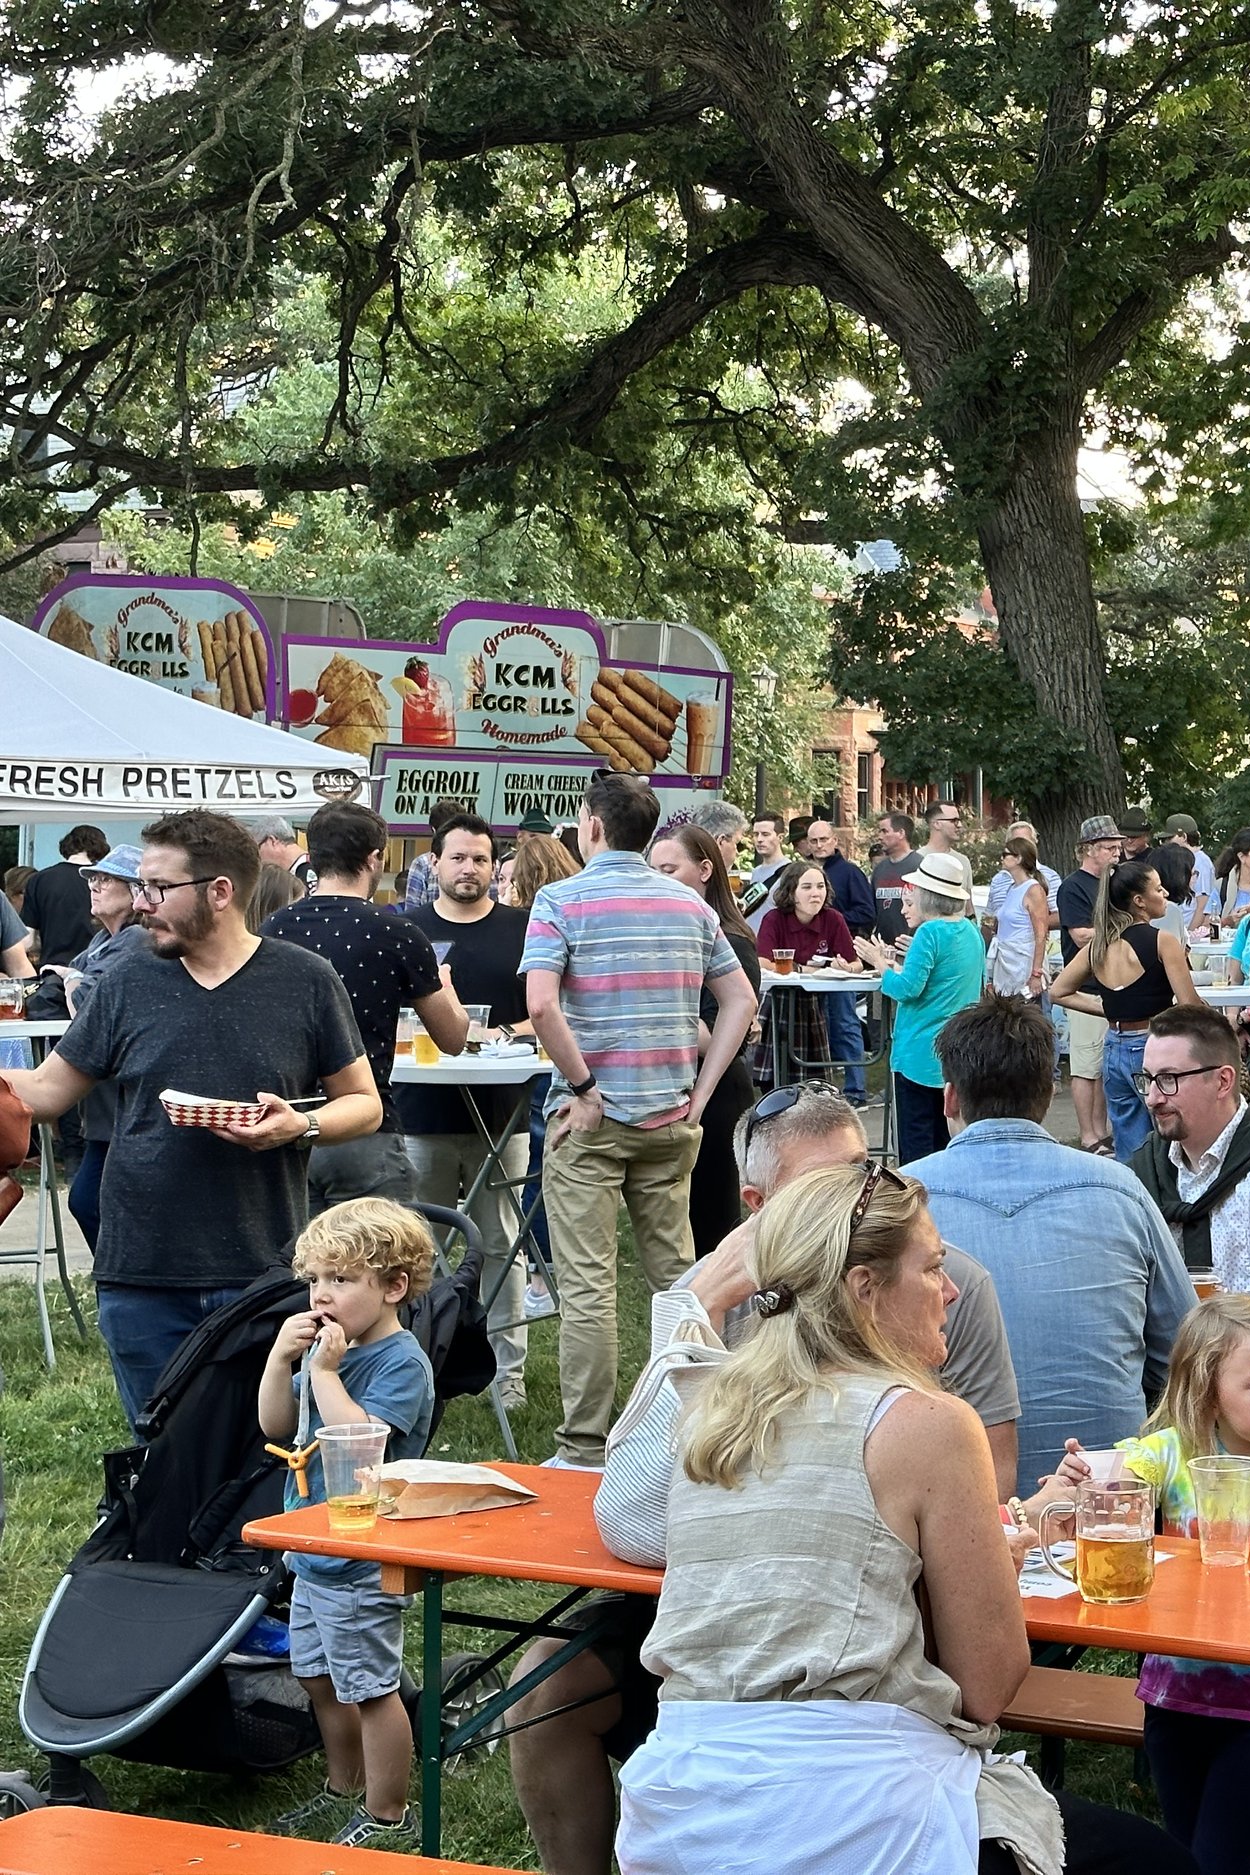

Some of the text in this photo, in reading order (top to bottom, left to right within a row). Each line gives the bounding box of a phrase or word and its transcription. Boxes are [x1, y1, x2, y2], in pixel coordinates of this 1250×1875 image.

[117, 592, 180, 628] Grandma's
[126, 631, 174, 655] KCM
[483, 622, 563, 659] Grandma's
[495, 663, 556, 690] KCM
[481, 718, 567, 745] Homemade
[122, 767, 297, 799] PRETZELS
[396, 769, 481, 795] EGGROLL
[504, 773, 544, 791] CREAM
[394, 795, 417, 815] ON
[420, 796, 431, 815] A
